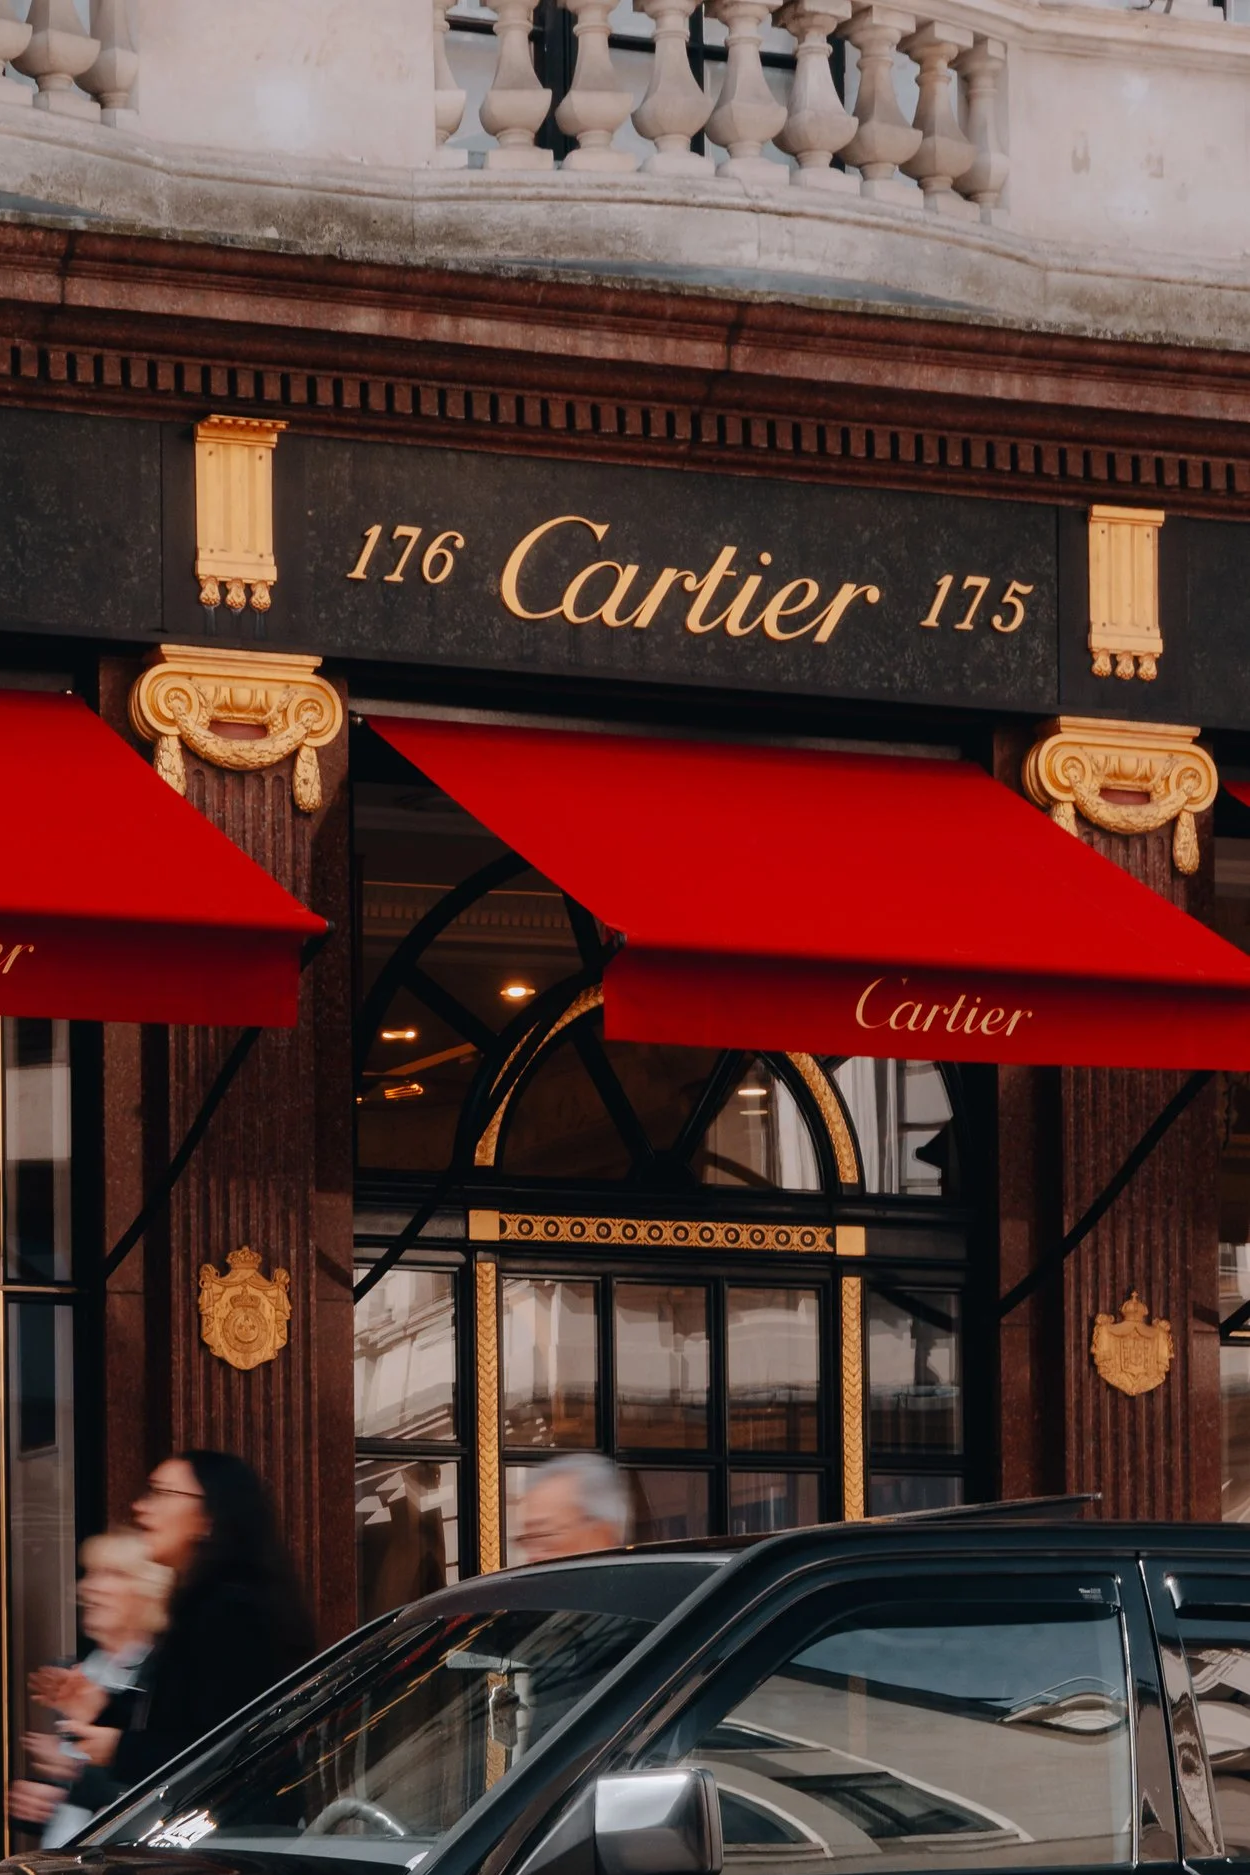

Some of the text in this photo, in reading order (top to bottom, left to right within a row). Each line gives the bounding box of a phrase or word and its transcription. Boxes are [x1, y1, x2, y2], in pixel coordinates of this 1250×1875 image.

[346, 515, 1034, 643] 176 Cartier 175
[855, 977, 1033, 1038] Cartier
